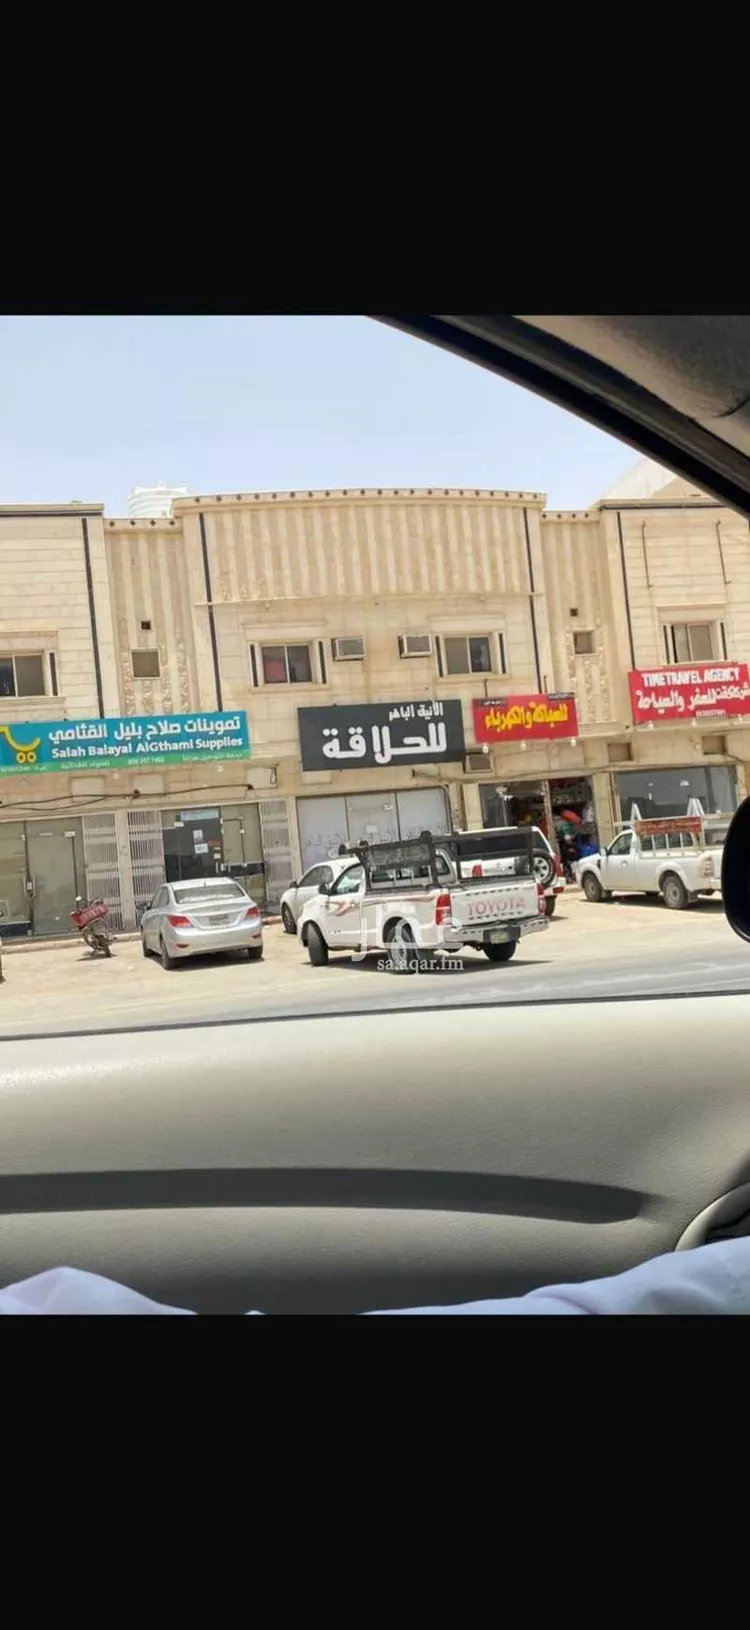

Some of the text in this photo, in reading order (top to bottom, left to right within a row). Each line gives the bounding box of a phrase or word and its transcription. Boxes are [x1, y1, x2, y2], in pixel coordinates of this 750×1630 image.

[703, 667, 740, 683] AGENCY
[48, 716, 241, 745] تموينات صلاح بليل القثامي
[52, 746, 86, 759] Salah
[87, 744, 132, 760] Balayal
[195, 736, 243, 752] Supplies
[322, 722, 447, 764] للحلاقة
[467, 896, 526, 916] TOYOTA
